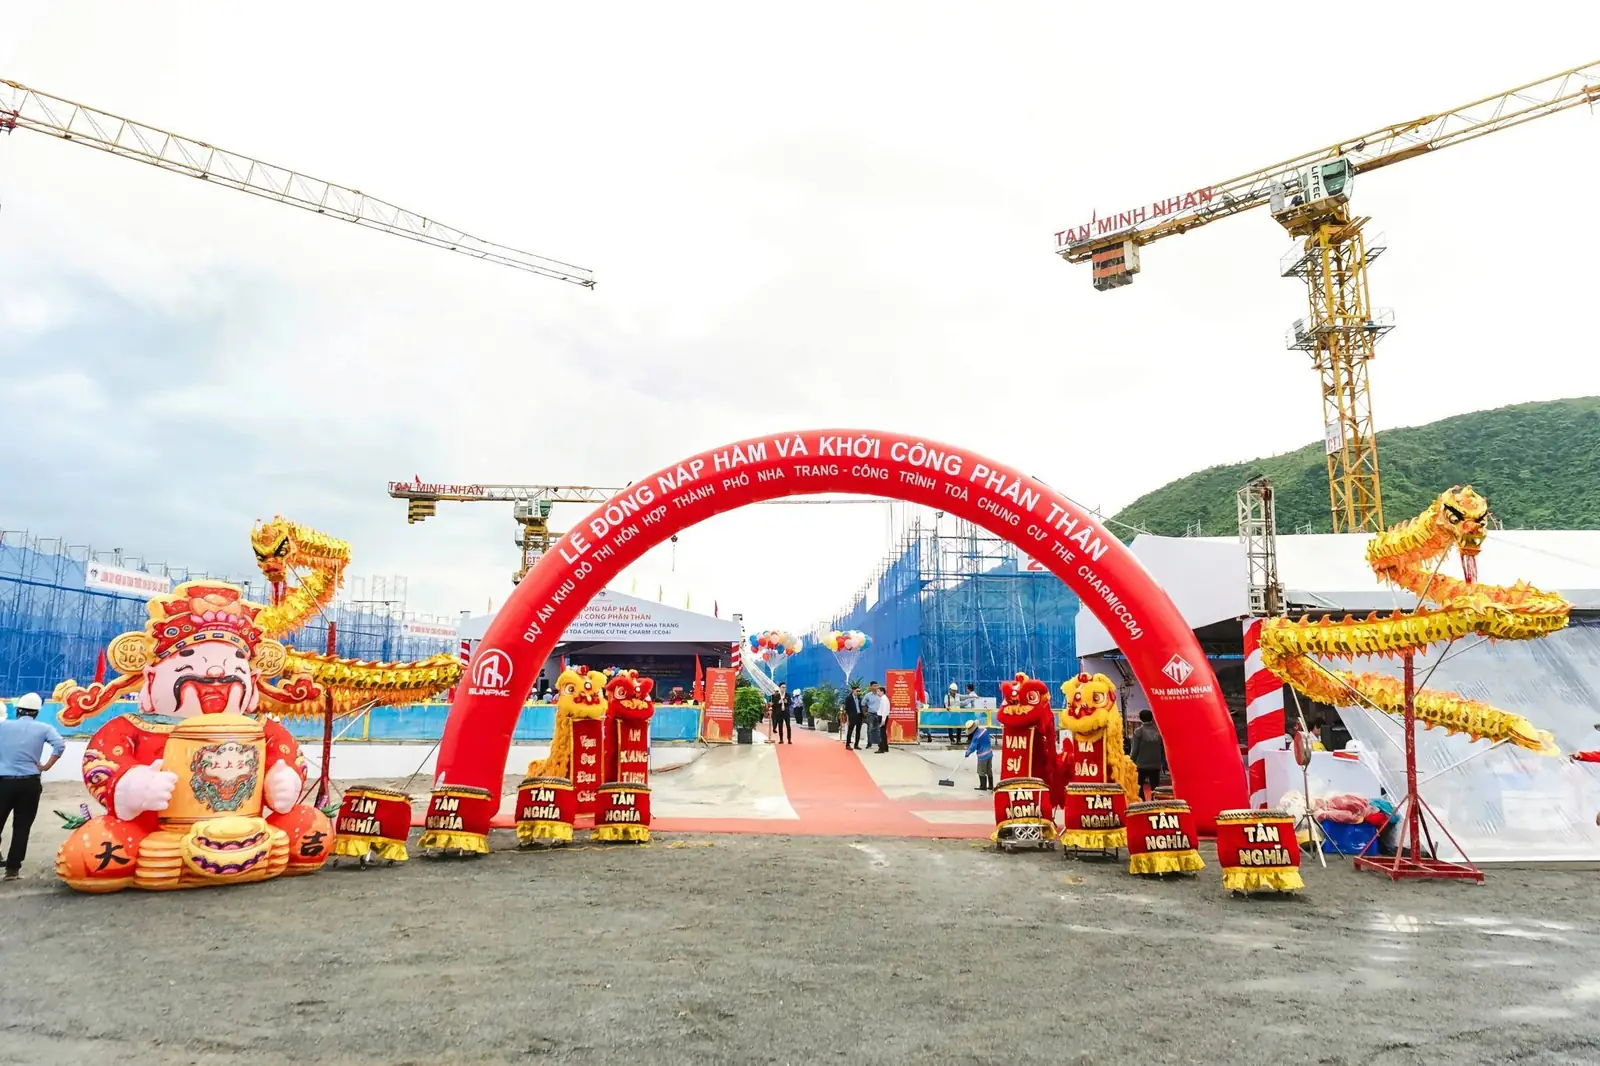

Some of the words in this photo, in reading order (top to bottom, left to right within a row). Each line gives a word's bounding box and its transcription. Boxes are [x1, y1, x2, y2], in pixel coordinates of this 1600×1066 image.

[1311, 165, 1320, 199] LIFTEC
[1098, 207, 1145, 234] MINH
[417, 483, 445, 493] MINH
[773, 434, 809, 458] VÀ
[819, 434, 880, 458] KHỞI
[890, 442, 963, 476] CÔNG
[969, 463, 1040, 512] PHẦN
[1045, 502, 1109, 562] THÂN
[523, 622, 542, 643] DỰ
[536, 604, 555, 623] ÁN
[551, 579, 575, 604] KHU
[574, 560, 593, 580] ĐÔ
[592, 545, 615, 567] THỊ
[641, 505, 668, 526] HỢP
[672, 483, 716, 509] THÀNH
[757, 468, 785, 482] NHA
[793, 464, 838, 477] TRANG
[851, 463, 889, 480] CÔNG
[899, 470, 937, 490] TRÌNH
[944, 482, 969, 502] TOÀ
[977, 497, 1021, 526] CHUNG
[1026, 524, 1048, 541] CƯ
[1051, 541, 1076, 564] THE
[1077, 565, 1144, 641] CHARM(CC04)
[468, 688, 511, 697] SUNPMC
[1167, 687, 1189, 695] MINH
[1005, 735, 1026, 751] VẠN
[1007, 756, 1022, 774] SỰ
[530, 785, 554, 802] TÂN
[612, 791, 635, 805] TÂN
[1085, 794, 1112, 809] TÂN
[351, 797, 377, 814] TÂN
[434, 796, 459, 811] TÂN
[523, 804, 560, 819] NGHĨA
[427, 815, 463, 830] NGHĨA
[605, 808, 640, 822] NGHĨA
[1081, 812, 1120, 827] NGHĨA
[1148, 812, 1179, 829] TÂN
[340, 816, 381, 835] NGHĨA
[1244, 822, 1279, 842] TÂN
[300, 831, 327, 856] 吉
[1145, 831, 1190, 850] NGHĨA
[95, 842, 131, 871] 大
[1239, 845, 1291, 865] NGHĨA
